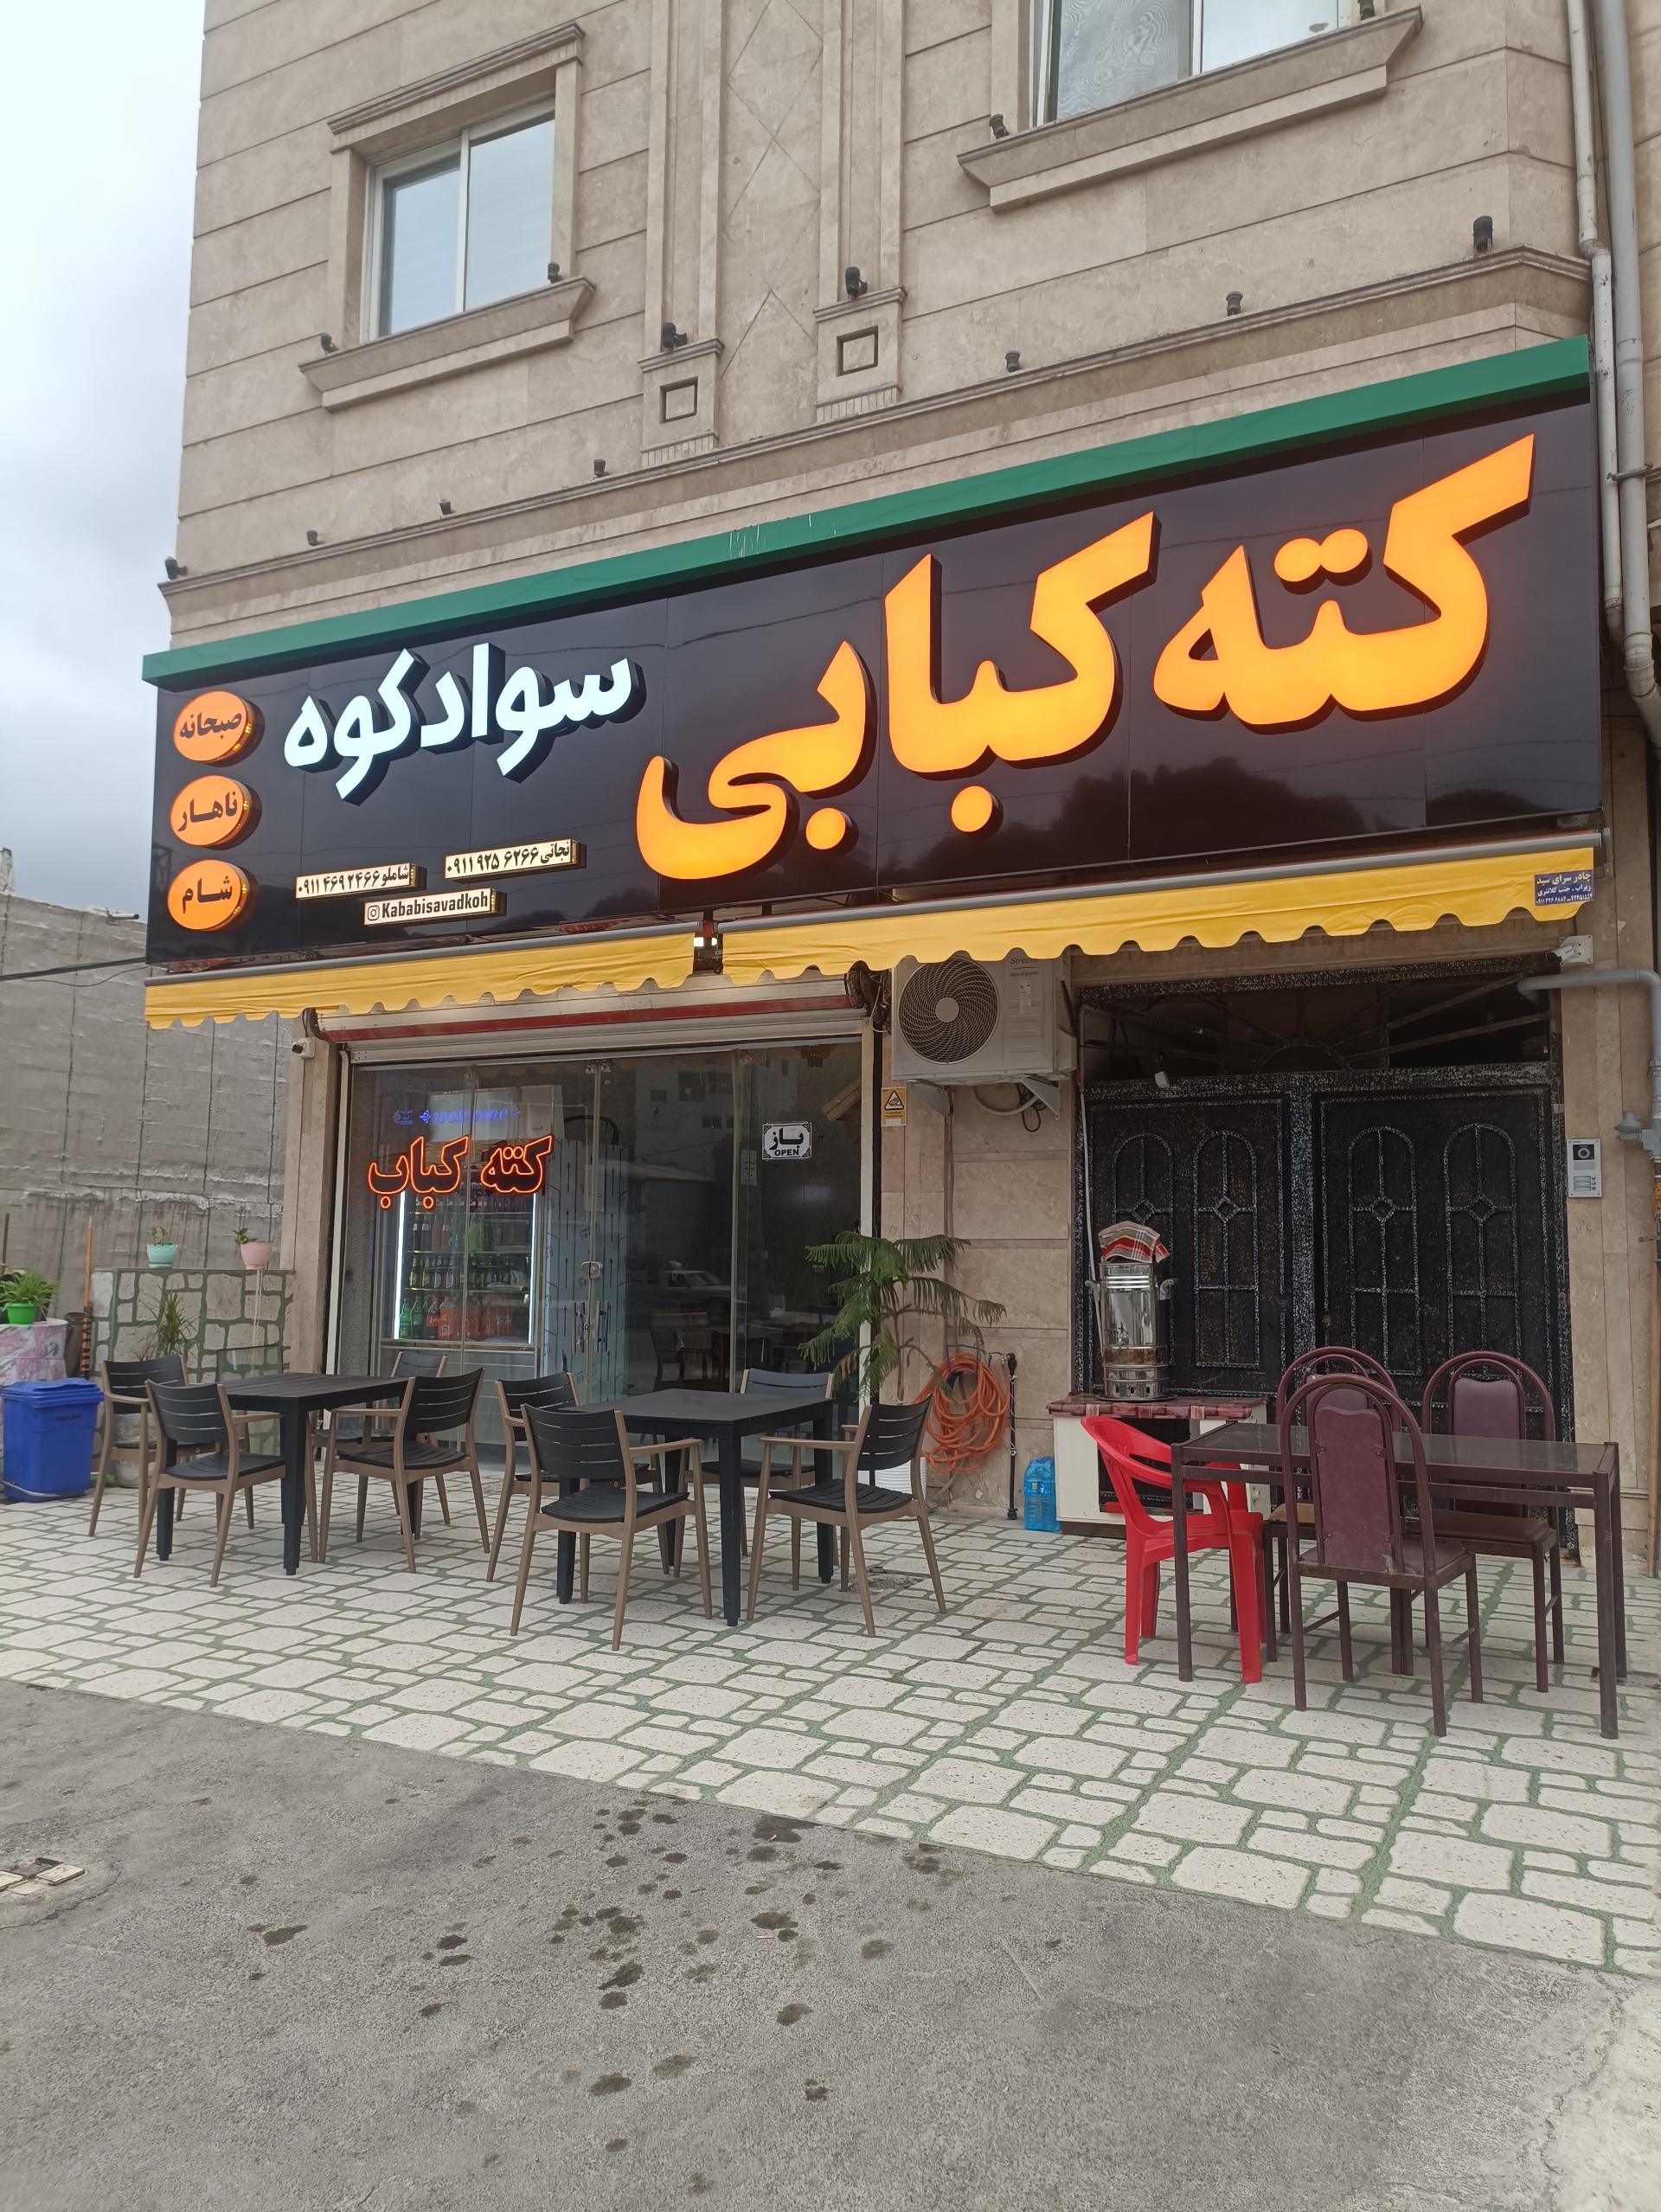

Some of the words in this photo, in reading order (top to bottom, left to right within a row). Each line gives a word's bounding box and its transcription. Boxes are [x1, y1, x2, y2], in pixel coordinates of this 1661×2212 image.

[1153, 433, 1535, 725] کته
[635, 510, 1155, 881] کبابی
[179, 711, 242, 740] صبحانه
[284, 642, 632, 799] سوادکوه
[177, 791, 238, 832] ناهار
[540, 841, 570, 863] نجاتی
[182, 875, 233, 914] شام
[382, 866, 409, 886] شاملو
[382, 891, 488, 919] Kababisavadkoh
[769, 1127, 804, 1150] باز
[368, 1135, 469, 1209] کباب
[481, 1135, 552, 1193] کته
